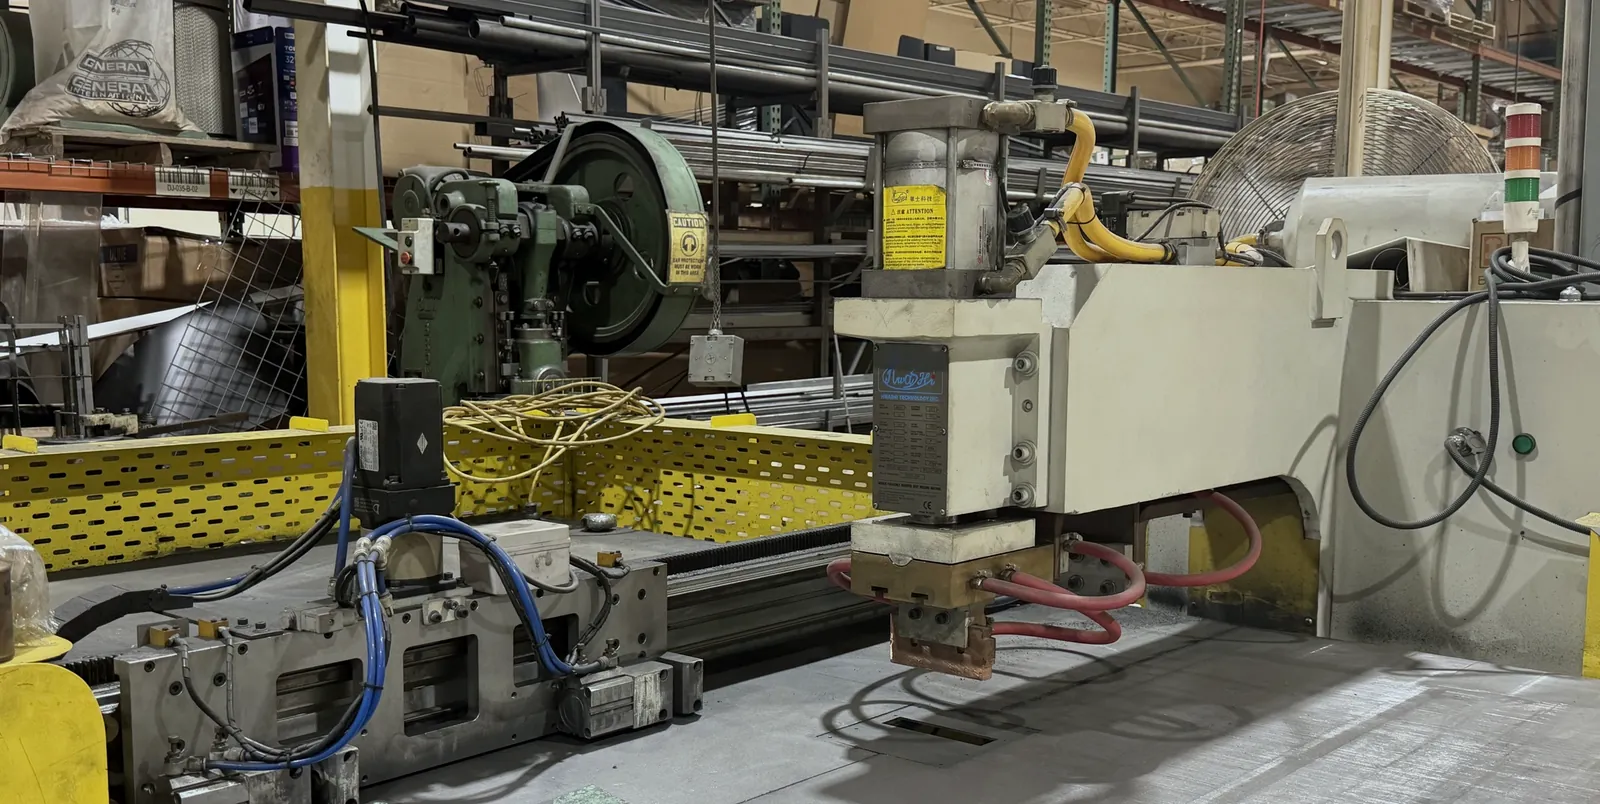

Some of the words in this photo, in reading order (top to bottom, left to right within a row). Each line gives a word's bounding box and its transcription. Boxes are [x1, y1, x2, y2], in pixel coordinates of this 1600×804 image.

[83, 57, 146, 73] GNERAL
[71, 76, 152, 95] GENERAL
[673, 217, 704, 227] CAUTION
